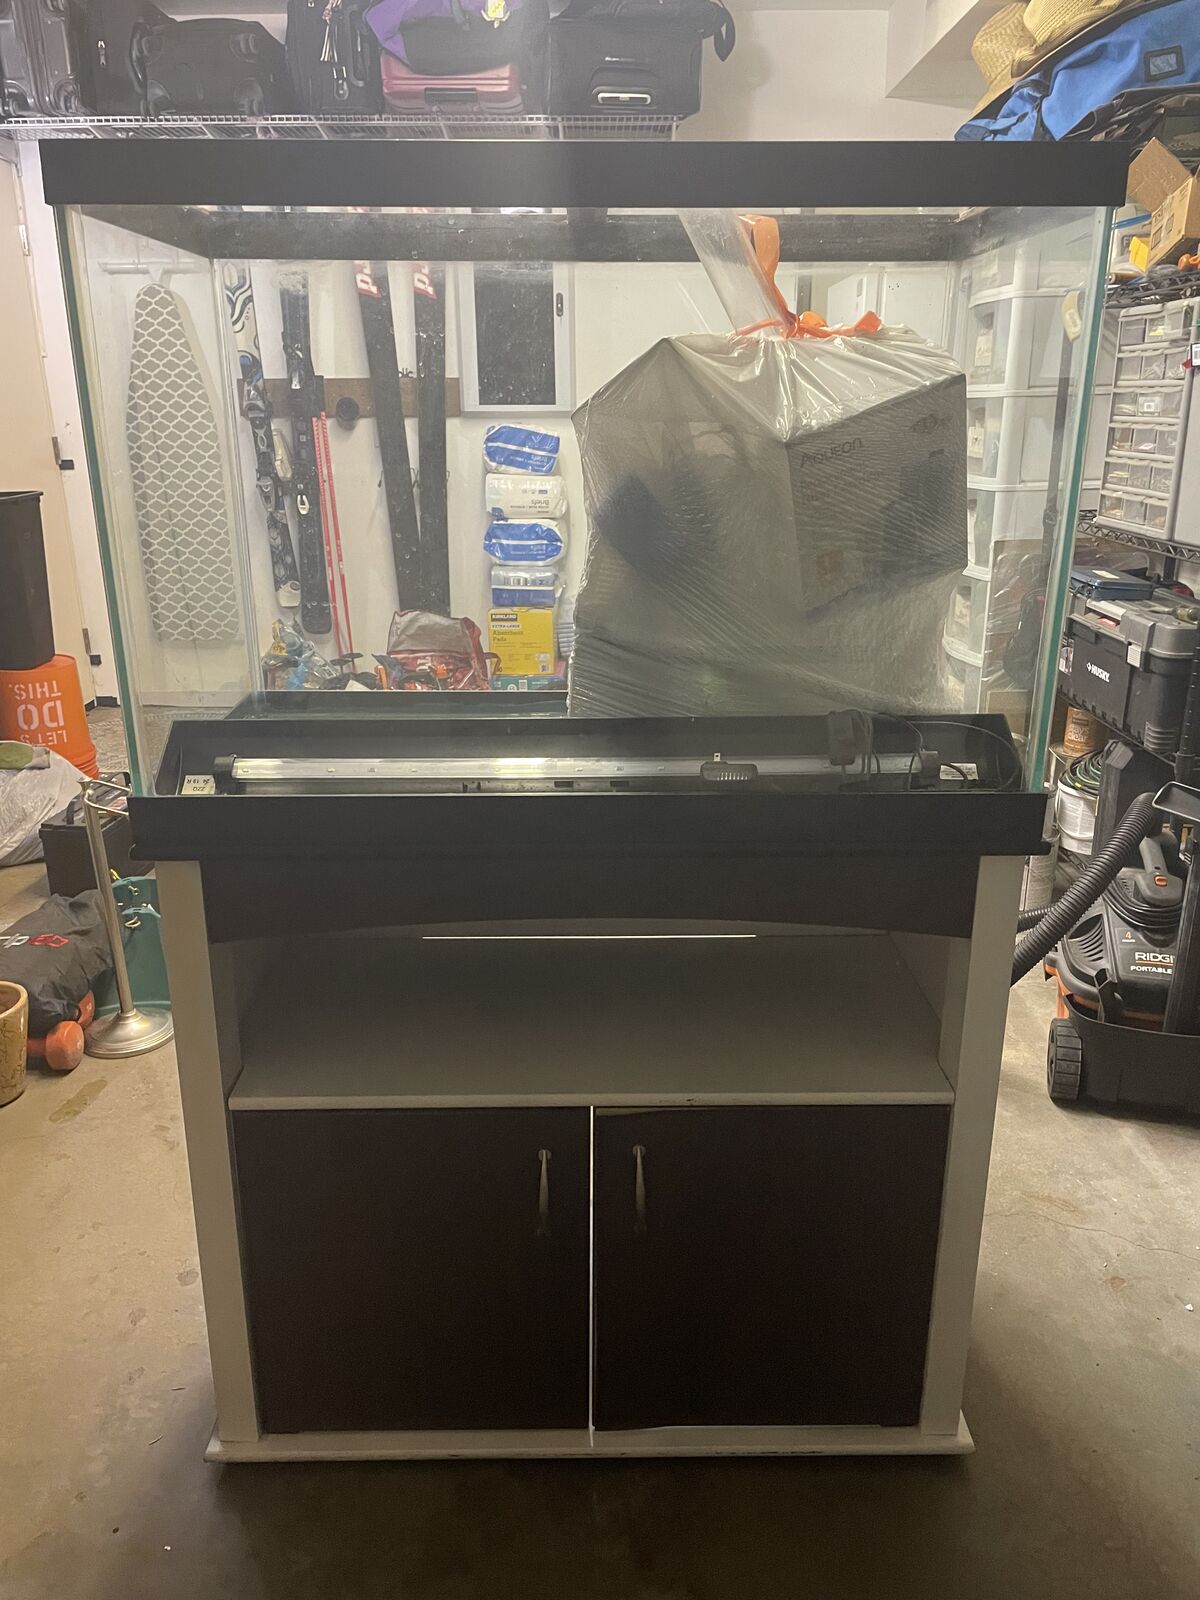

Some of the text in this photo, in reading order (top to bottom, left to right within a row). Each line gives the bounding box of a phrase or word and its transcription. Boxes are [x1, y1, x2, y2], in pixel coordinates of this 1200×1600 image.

[1091, 664, 1110, 682] HUSKY
[9, 680, 61, 700] THIS.
[17, 700, 64, 731] DO
[1125, 931, 1132, 939] 4
[1130, 965, 1173, 975] PORTABLE
